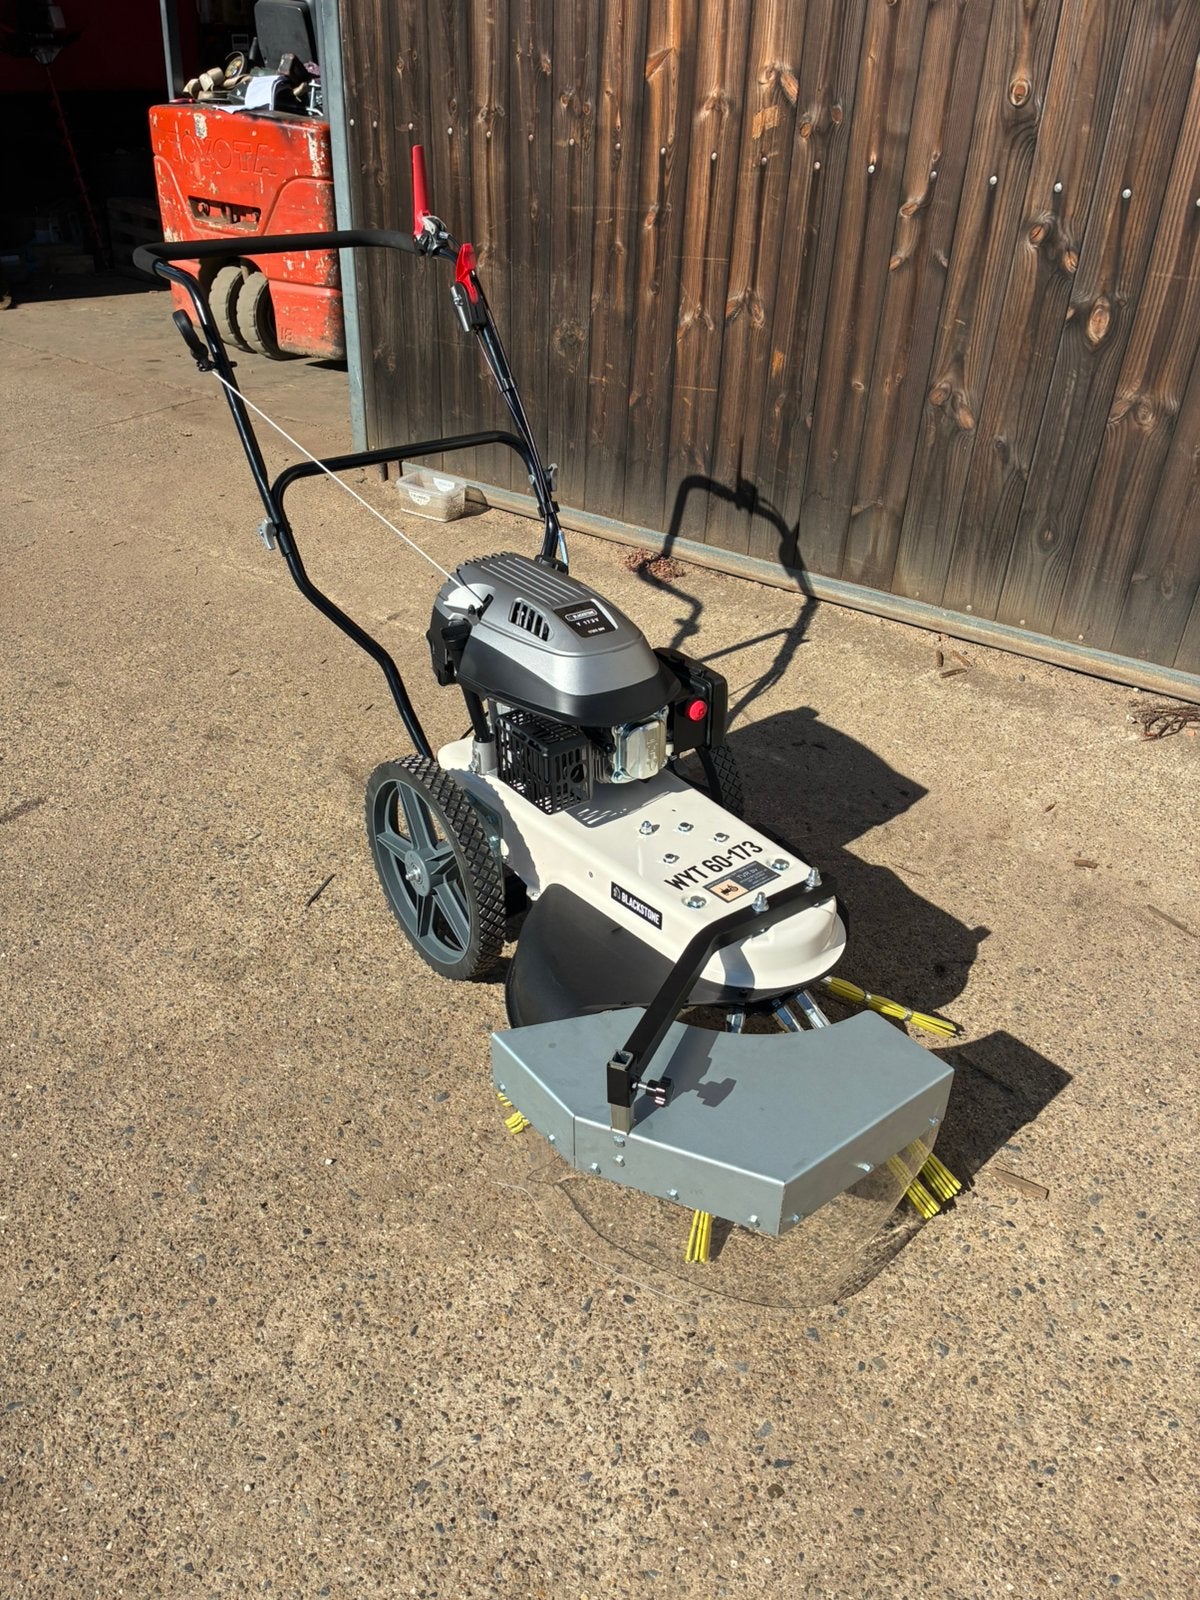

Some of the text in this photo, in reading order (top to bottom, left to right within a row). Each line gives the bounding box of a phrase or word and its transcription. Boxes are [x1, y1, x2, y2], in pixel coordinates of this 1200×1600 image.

[167, 131, 279, 177] TOYOTA
[664, 865, 708, 891] WYT
[702, 841, 763, 872] 60-173
[621, 890, 661, 926] BLACKSTONE
